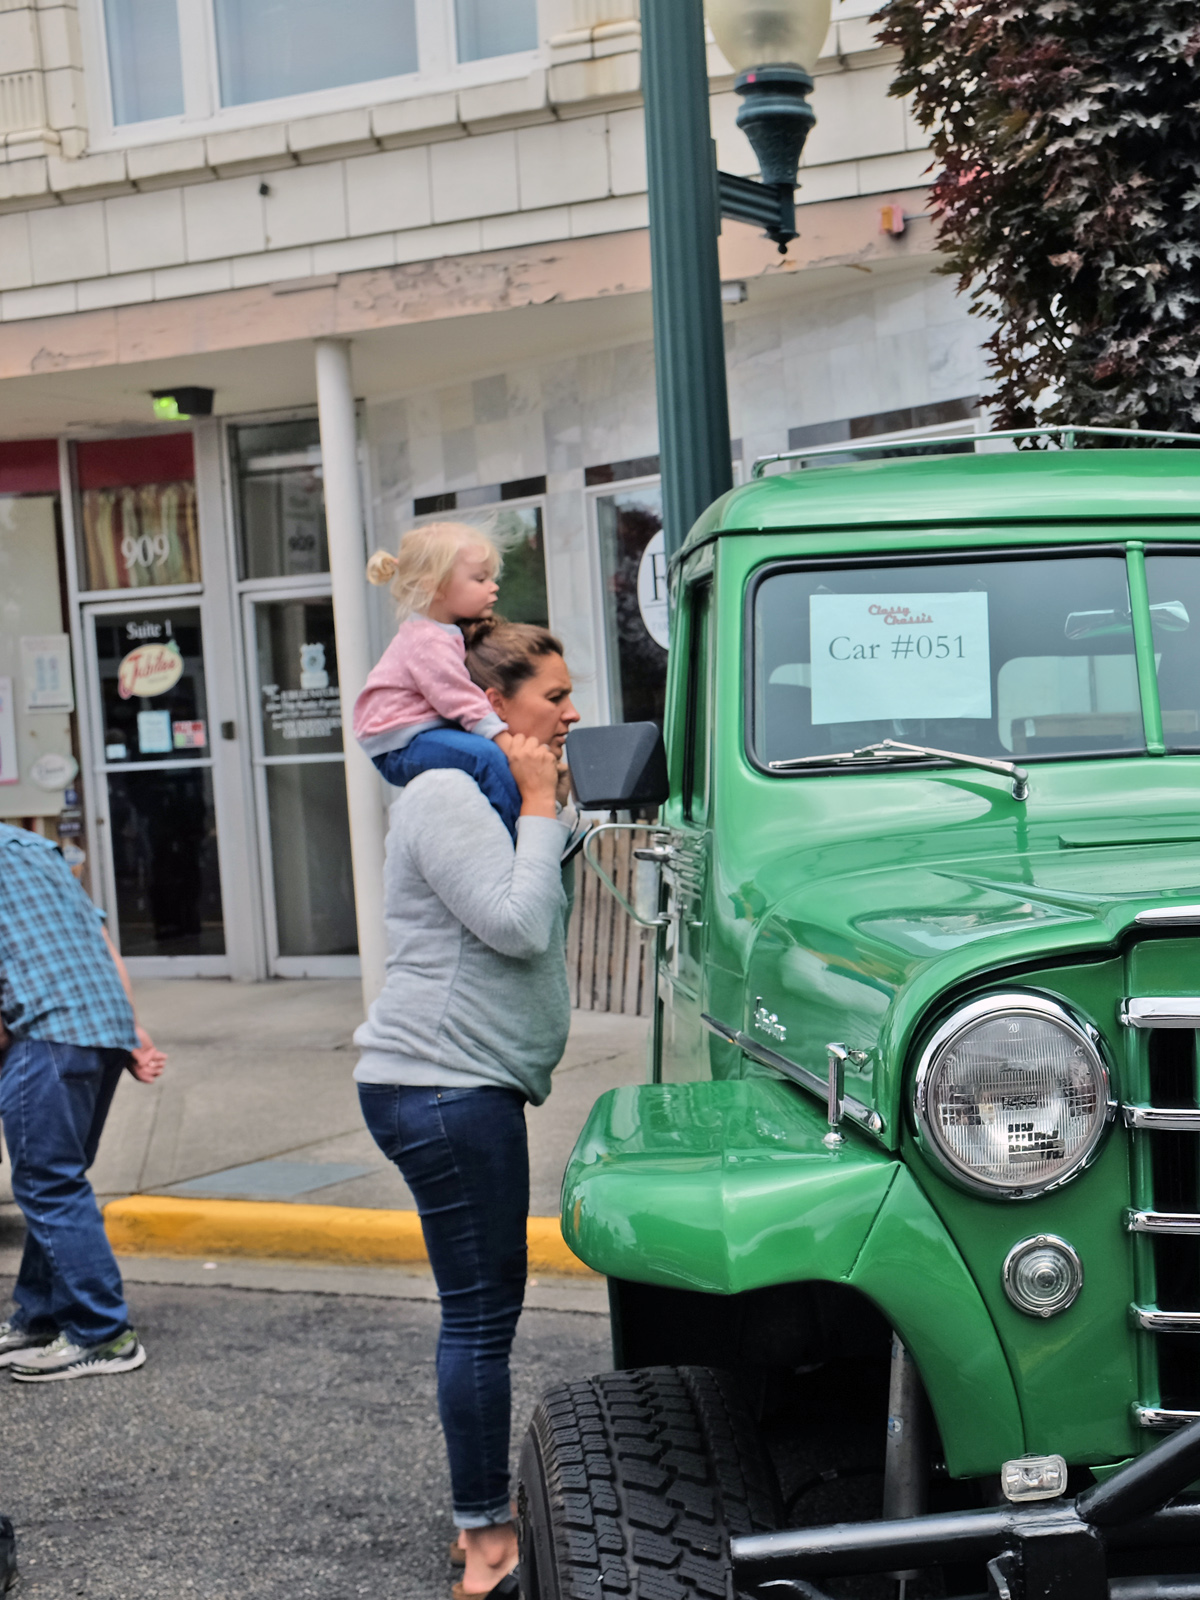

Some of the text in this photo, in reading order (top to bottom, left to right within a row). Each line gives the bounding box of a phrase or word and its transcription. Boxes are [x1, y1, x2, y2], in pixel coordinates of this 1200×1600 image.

[121, 534, 170, 569] 909
[868, 604, 911, 617] Classy
[884, 612, 934, 626] Chassis
[126, 618, 172, 640] Suite 1
[828, 634, 966, 661] Car #051
